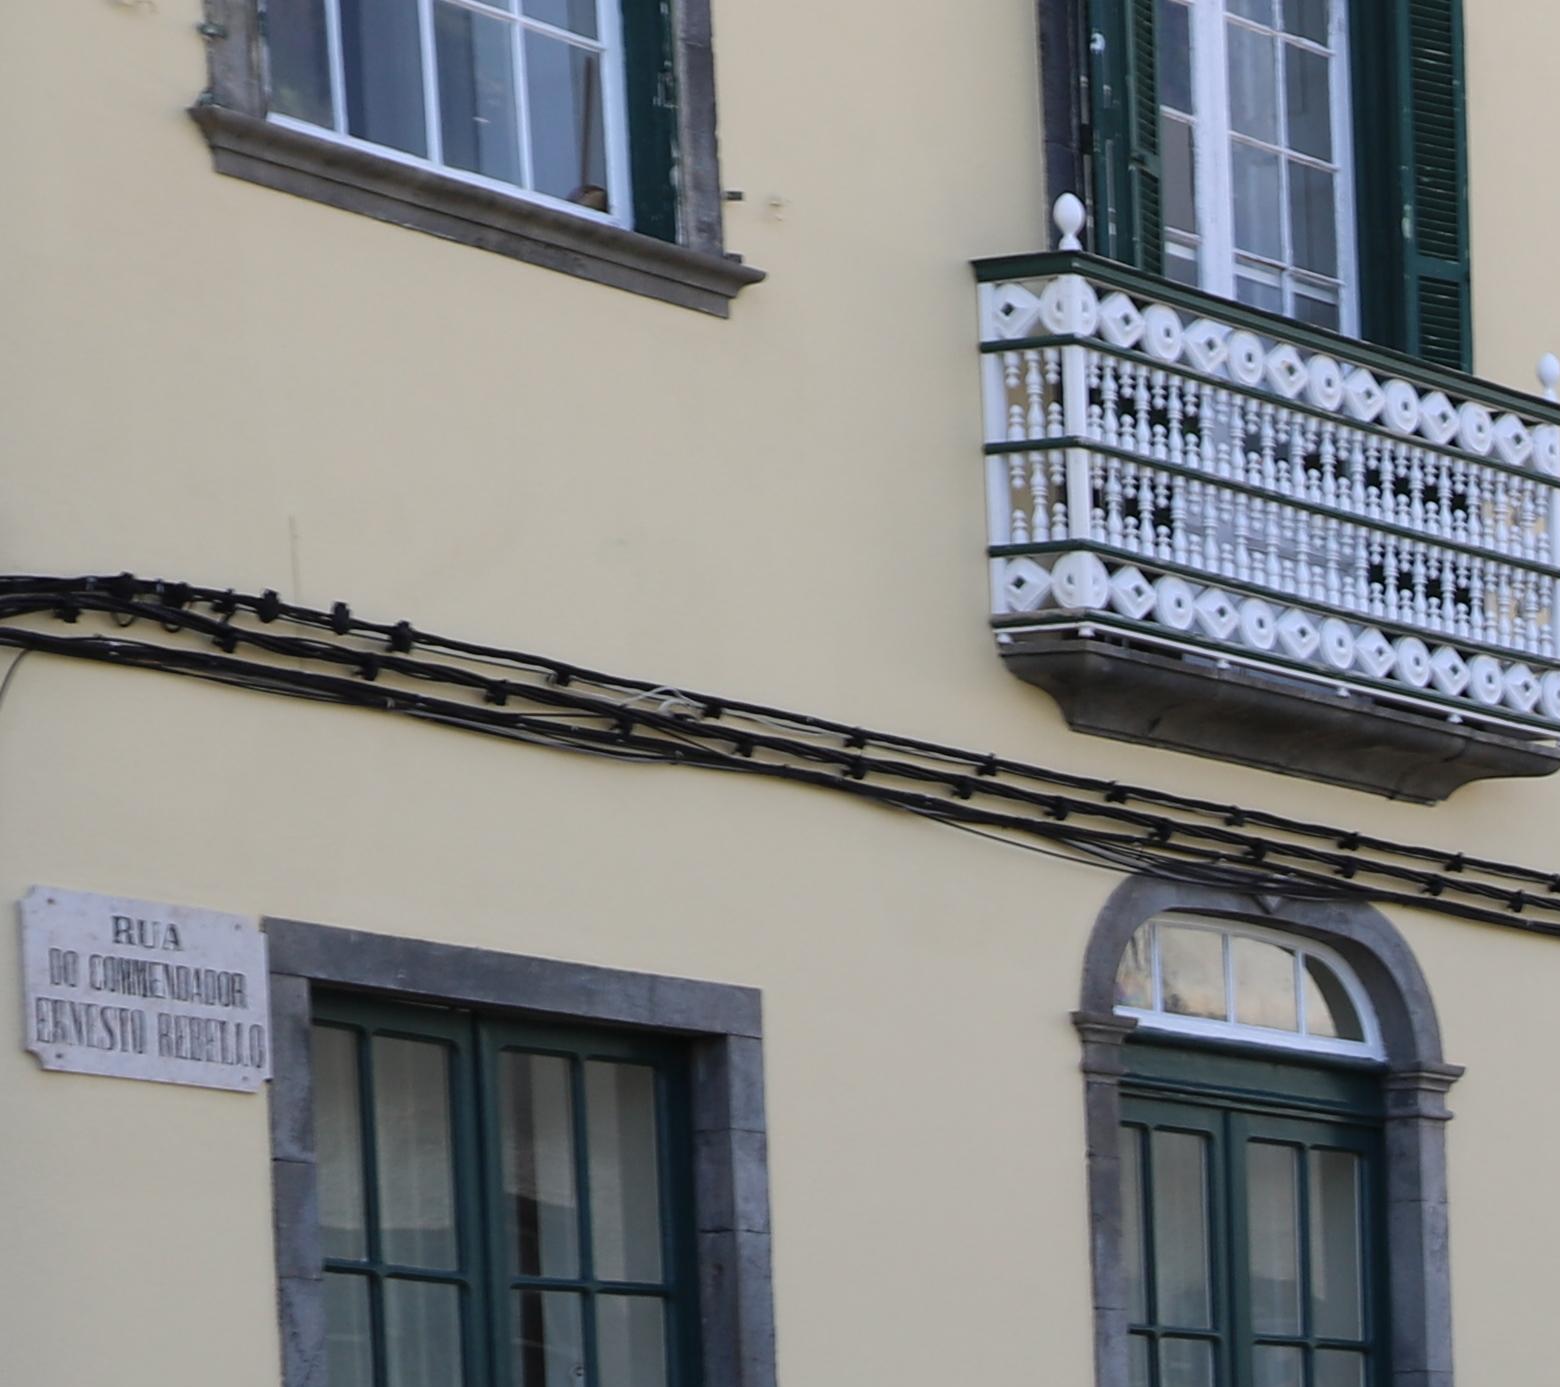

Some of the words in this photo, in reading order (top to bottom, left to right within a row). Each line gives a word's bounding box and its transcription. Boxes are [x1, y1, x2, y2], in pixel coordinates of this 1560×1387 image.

[111, 914, 184, 952] RUA
[48, 946, 79, 989] DO
[87, 953, 249, 1009] COMMENDADOR
[35, 996, 146, 1055] ERNESTO
[156, 1012, 267, 1069] REBELLO
